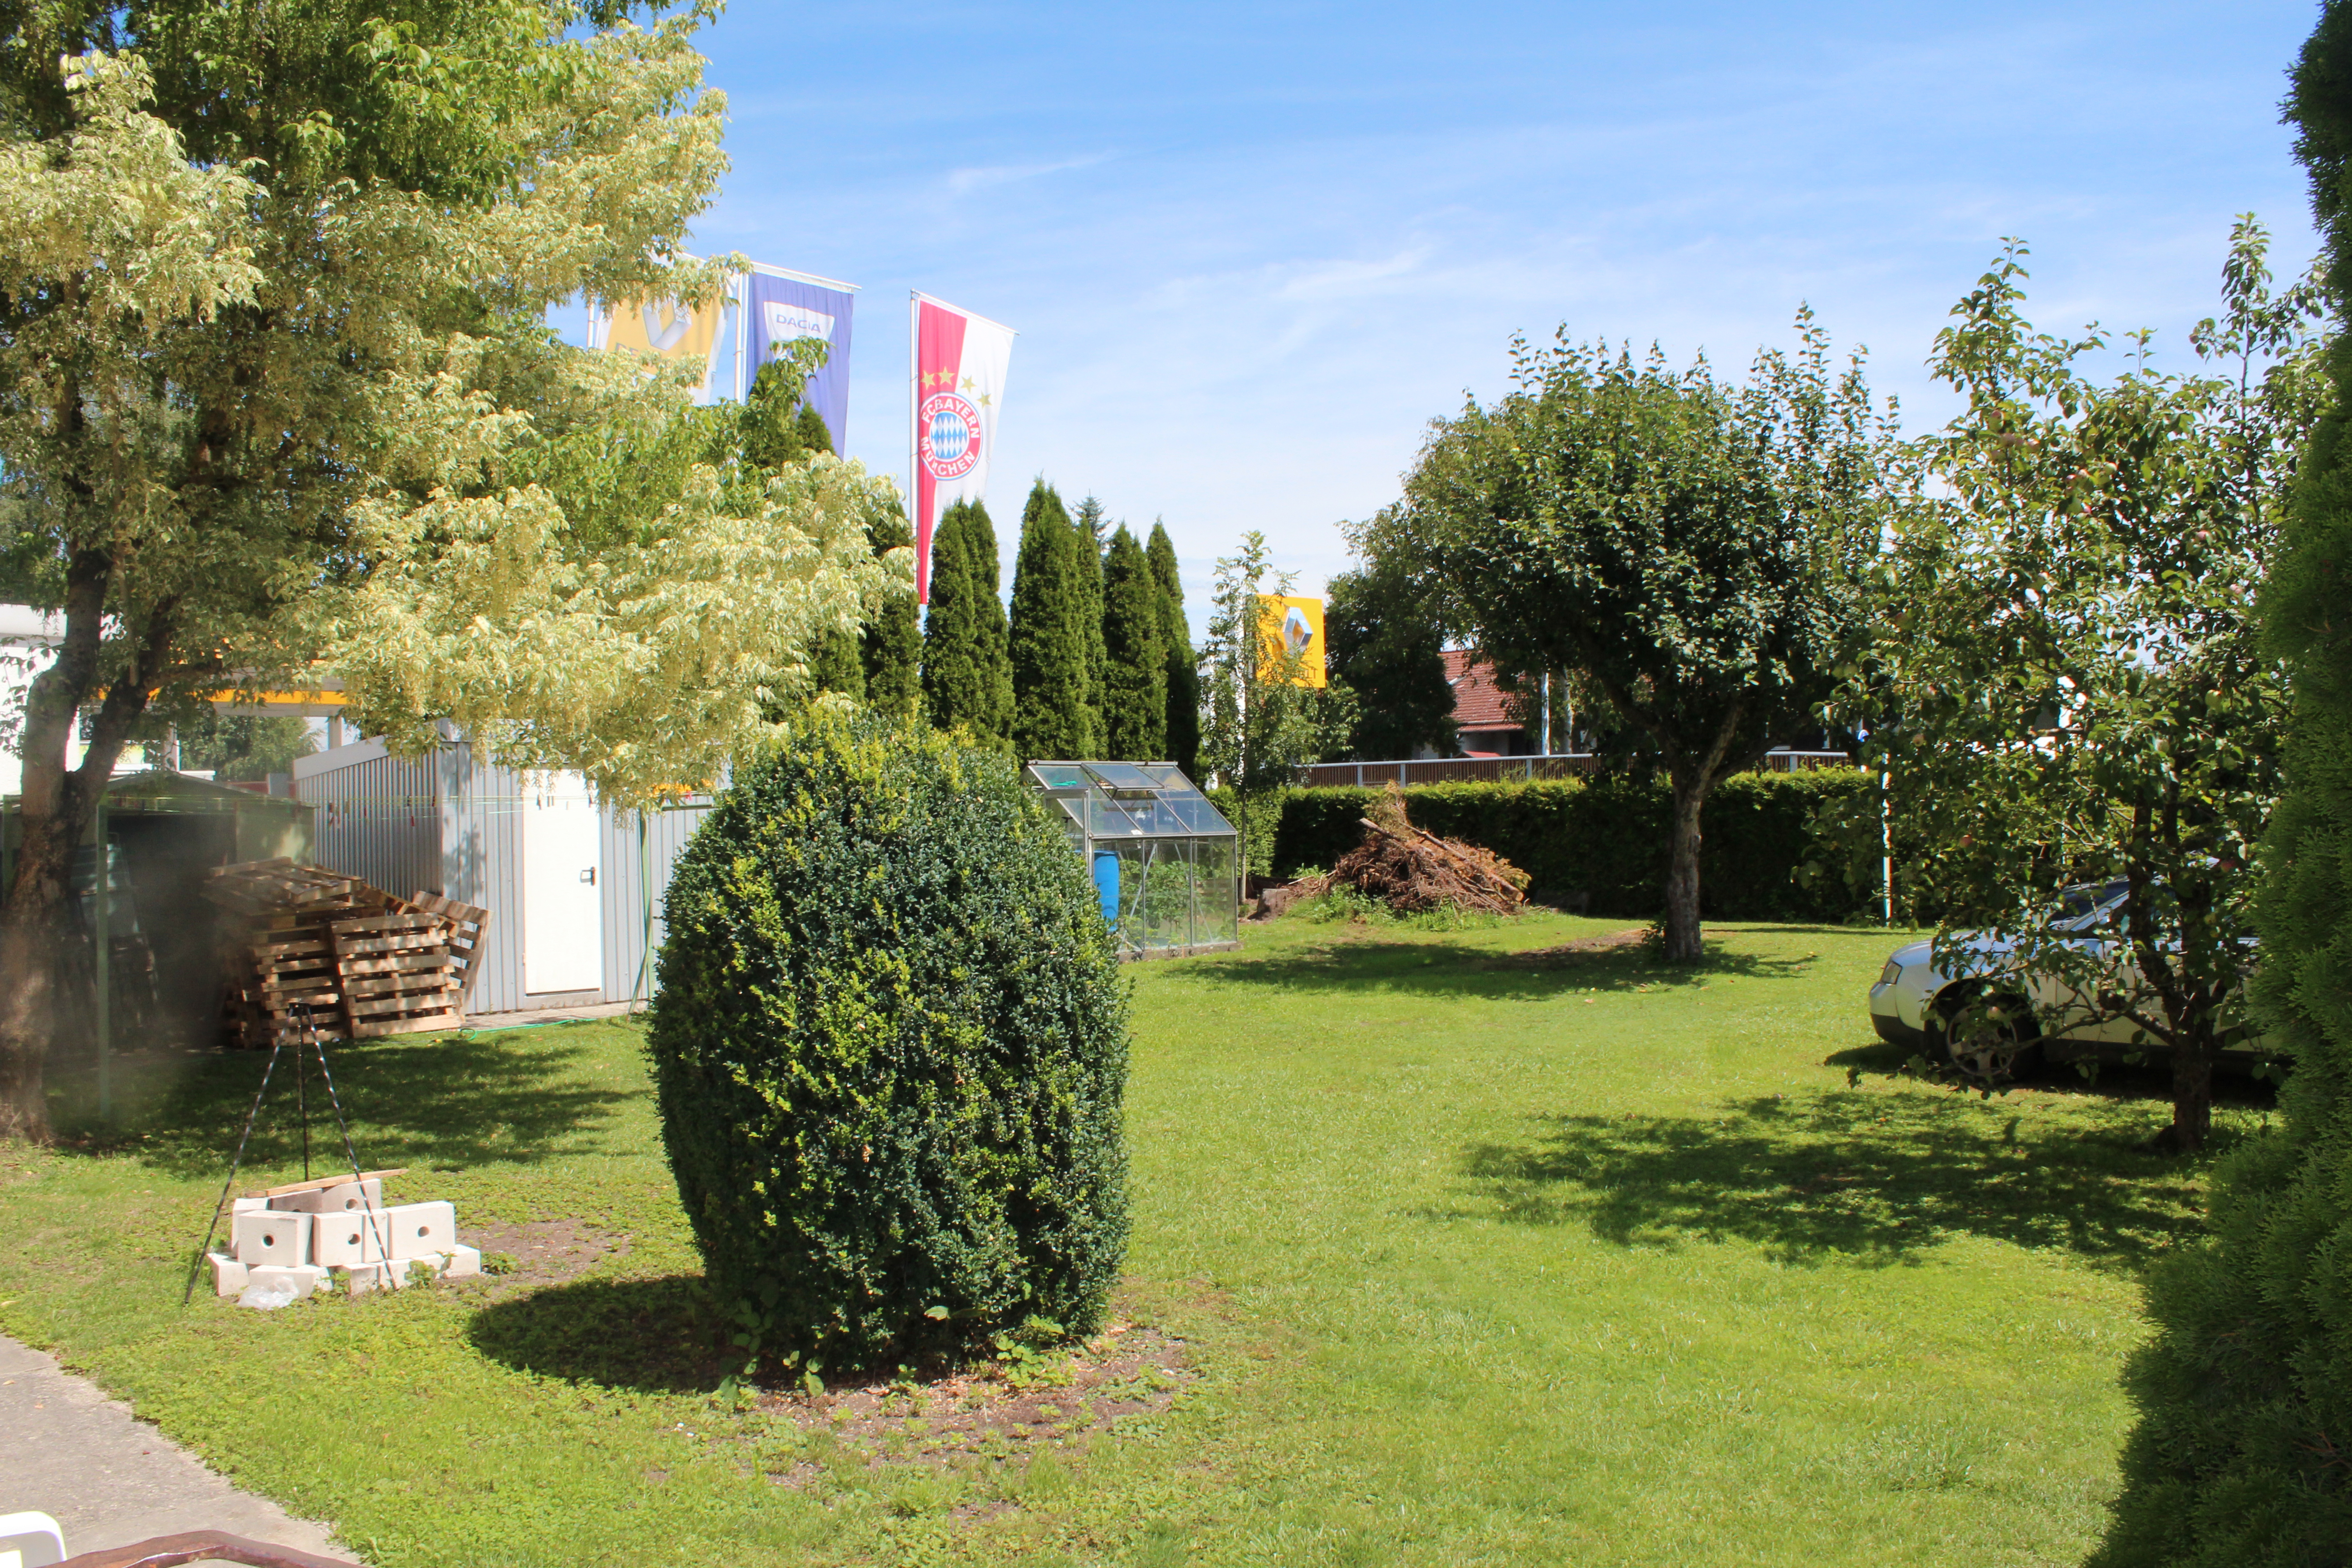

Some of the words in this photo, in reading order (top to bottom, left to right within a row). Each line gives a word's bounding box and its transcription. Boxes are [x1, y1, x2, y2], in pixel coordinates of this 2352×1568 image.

[776, 314, 821, 333] DACIA
[921, 404, 936, 423] FC
[935, 398, 980, 438] BAYERN
